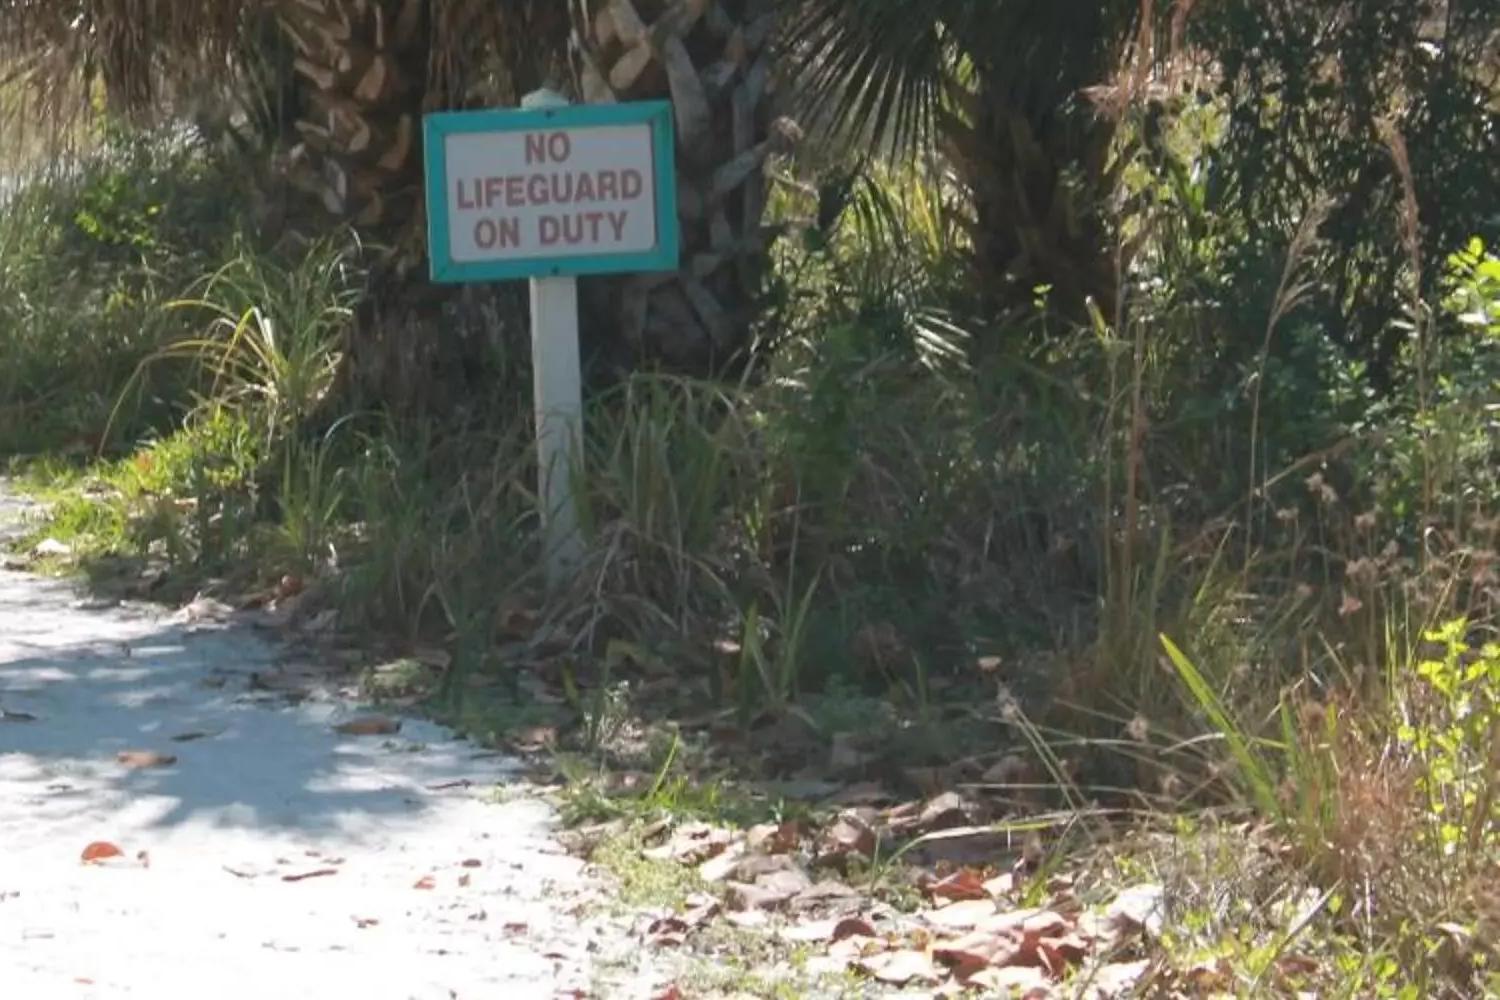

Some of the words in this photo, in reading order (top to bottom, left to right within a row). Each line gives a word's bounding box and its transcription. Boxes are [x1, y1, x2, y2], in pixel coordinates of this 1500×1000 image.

[525, 132, 571, 164] NO
[457, 169, 642, 210] LIFEGUARD
[474, 216, 520, 249] ON
[538, 211, 628, 245] DUTY
